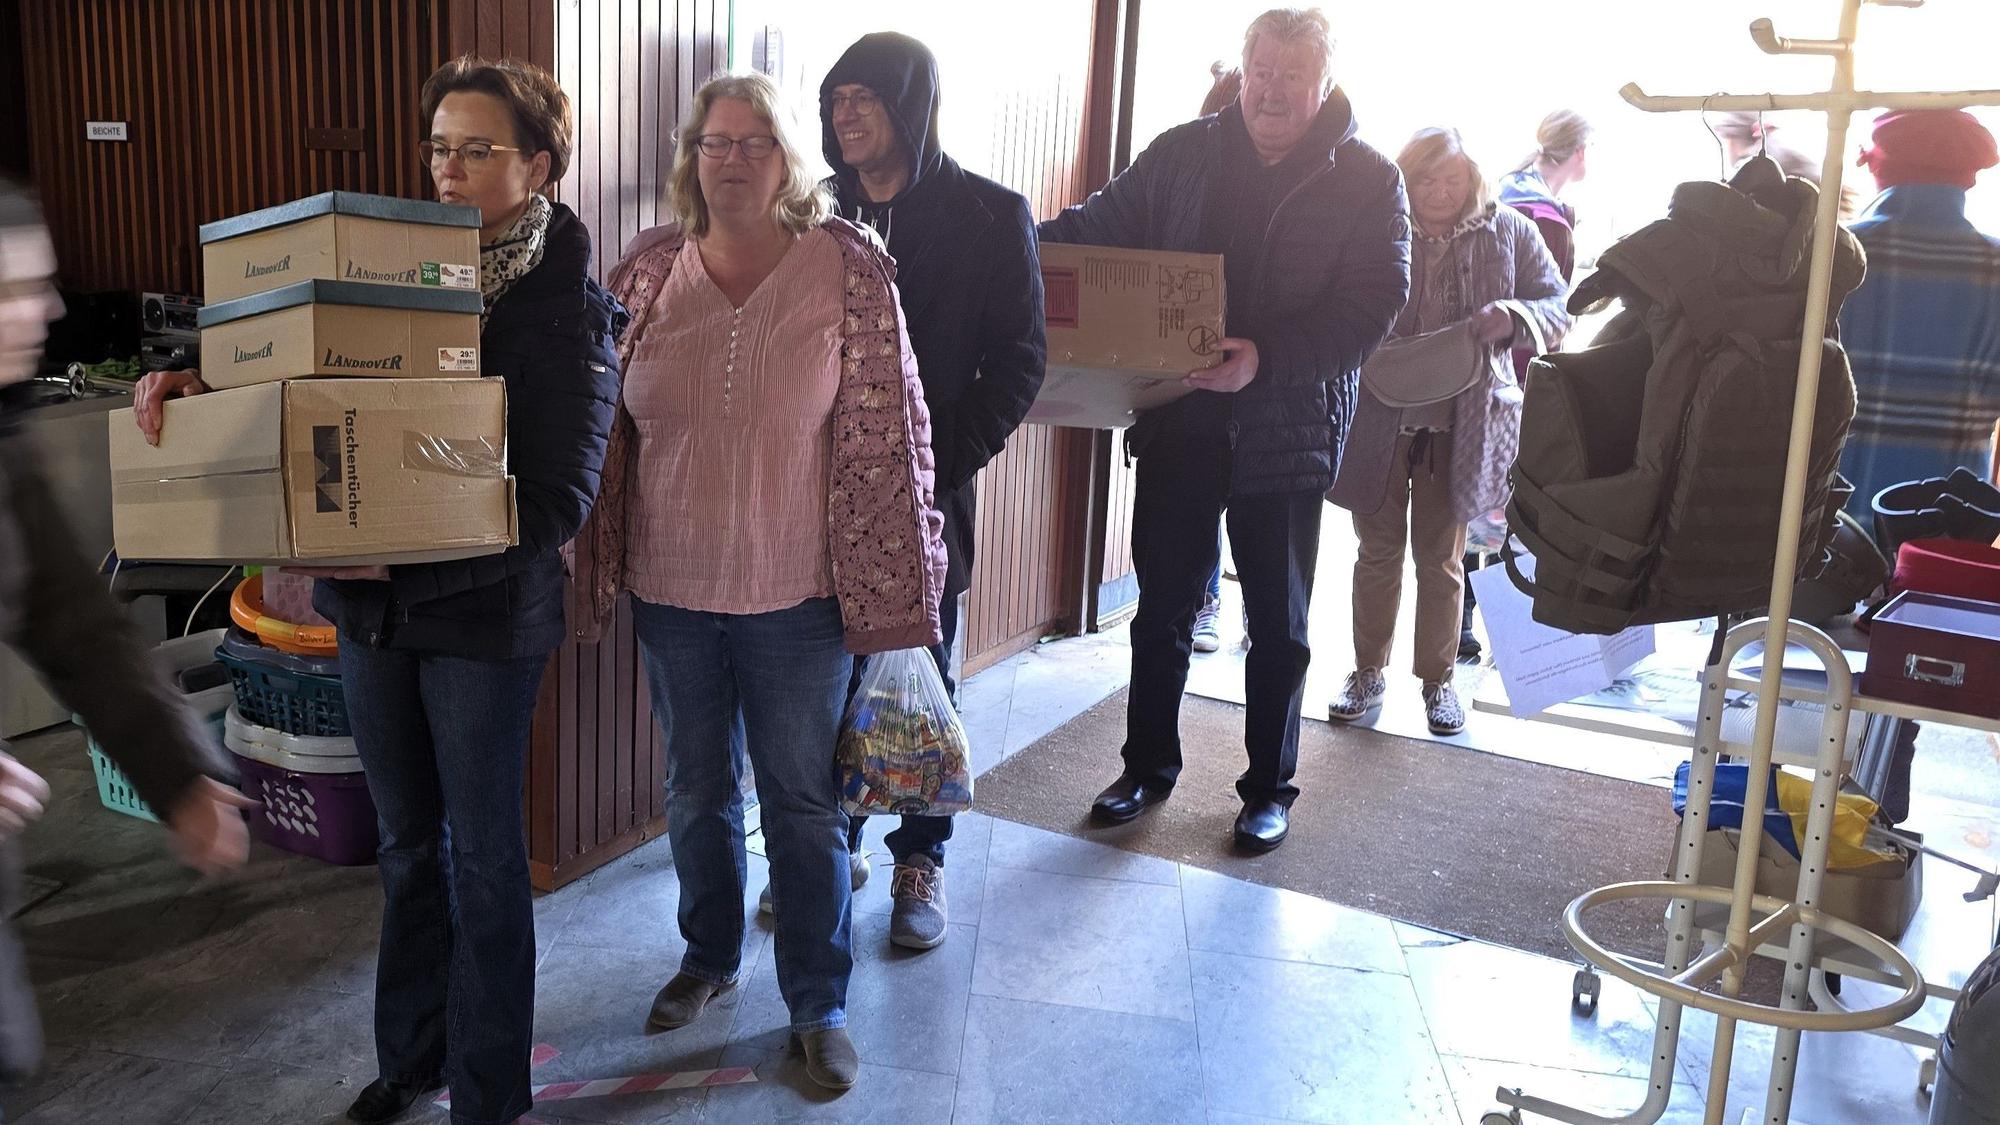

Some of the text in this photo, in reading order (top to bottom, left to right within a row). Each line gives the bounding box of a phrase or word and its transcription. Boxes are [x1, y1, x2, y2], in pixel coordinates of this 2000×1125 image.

[92, 126, 121, 136] BEICHTE
[244, 254, 290, 279] LANDROVER
[344, 259, 417, 283] LANDROVER
[233, 341, 273, 364] LANDROVER
[323, 347, 402, 370] LANDROVER
[344, 407, 361, 528] Taschentücher
